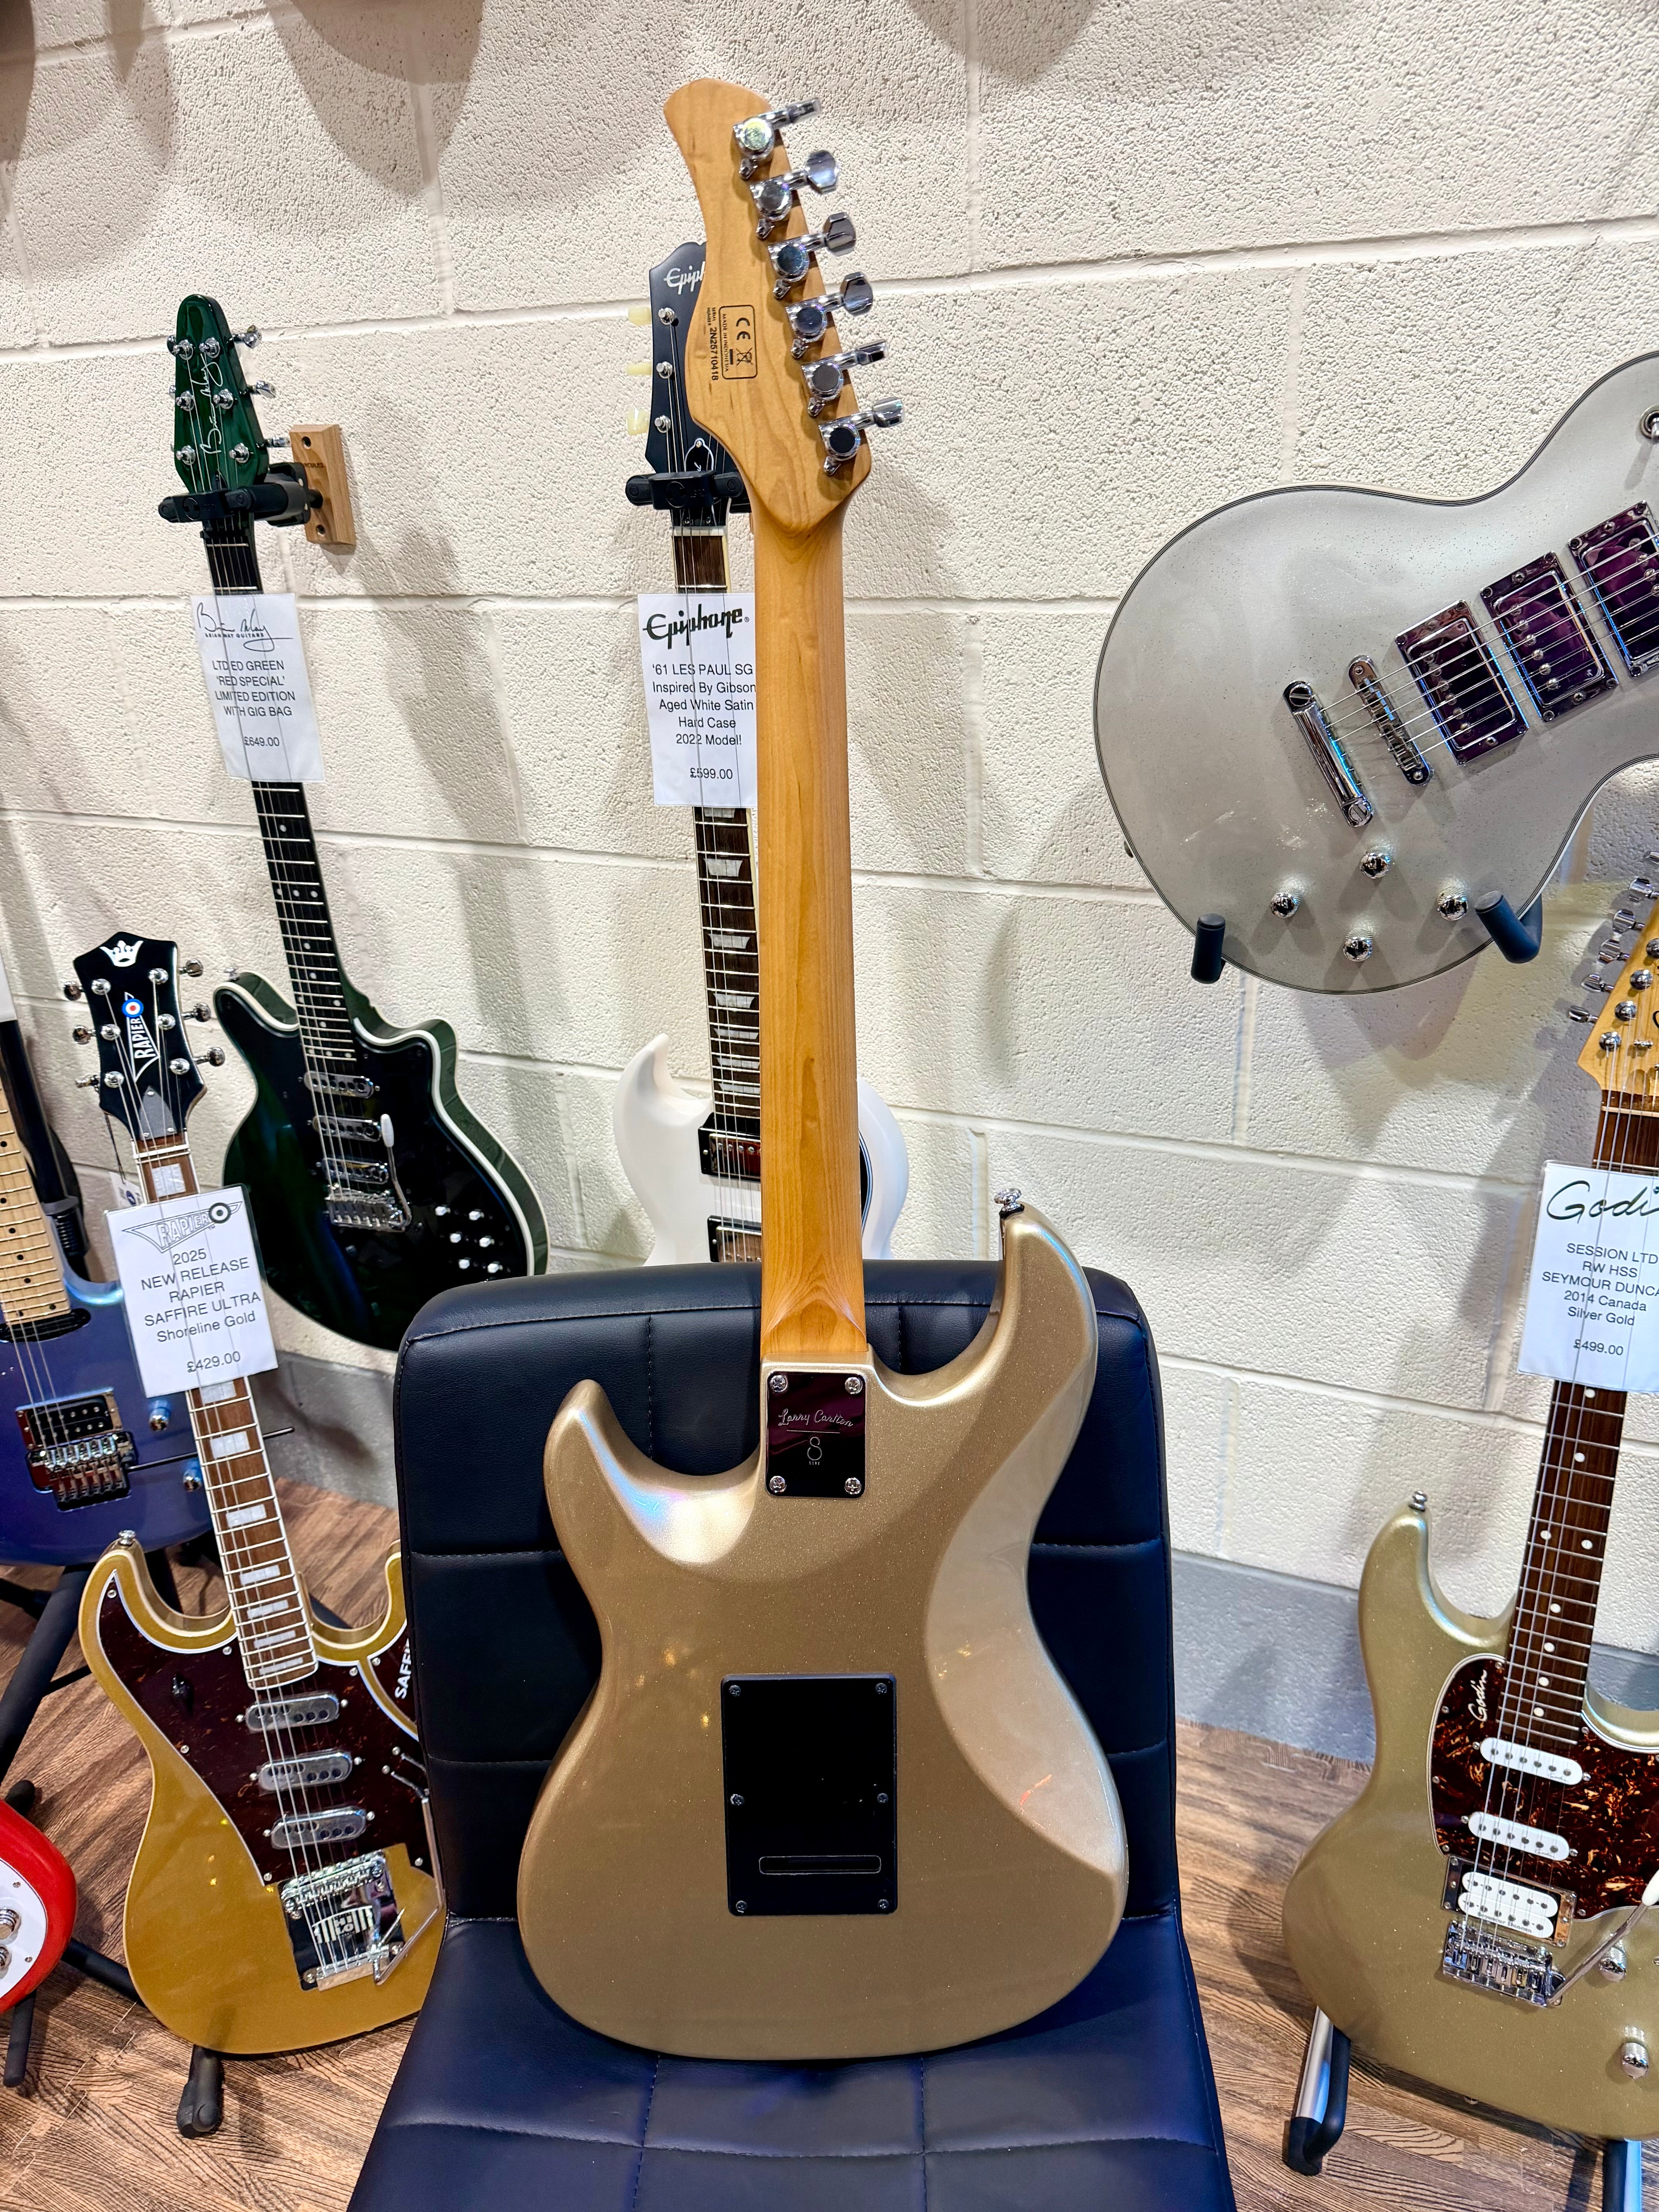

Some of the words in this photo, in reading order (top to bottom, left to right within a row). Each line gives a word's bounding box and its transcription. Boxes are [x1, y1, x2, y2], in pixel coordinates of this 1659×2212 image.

[663, 261, 706, 295] Epip
[643, 603, 743, 650] Epiphone
[212, 660, 228, 670] LTD
[231, 661, 244, 670] ED
[247, 660, 285, 670] GREEN
[672, 664, 695, 675] LES
[699, 664, 731, 675] PAUL
[735, 663, 754, 675] SG
[215, 691, 249, 701] LIMITED
[252, 691, 295, 701] EDITION
[653, 681, 695, 696] Inspired
[699, 682, 713, 696] By
[716, 682, 756, 693] Gibson
[223, 706, 246, 716] WITH
[247, 706, 266, 716] GIG
[269, 706, 292, 716] BAG
[659, 699, 687, 713] Aged
[692, 699, 721, 711] White
[724, 699, 754, 711] Satin
[678, 716, 704, 728] Hard
[707, 716, 736, 728] Case
[244, 737, 280, 747] £649.00
[675, 733, 702, 745] 2022
[705, 734, 742, 745] Model!
[690, 768, 733, 780] £599.00
[130, 1018, 156, 1059] RAPIER
[1546, 1180, 1659, 1224] Godi
[156, 1212, 210, 1249] RAPIER
[173, 1248, 207, 1265] 2025
[1566, 1243, 1628, 1261] SESSION
[1632, 1251, 1659, 1264] LTD
[141, 1272, 176, 1290] NEW
[180, 1257, 250, 1282] RELEASE
[1582, 1261, 1606, 1273] RW
[1609, 1264, 1638, 1278] HSS
[169, 1281, 225, 1303] RAPIER
[1541, 1271, 1611, 1291] SEYMOUR
[1615, 1281, 1659, 1297] DUNCA
[144, 1302, 208, 1326] SAFFIRE
[211, 1291, 261, 1312] ULTRA
[1563, 1290, 1594, 1303] 2014
[1598, 1295, 1647, 1312] Canada
[1568, 1307, 1602, 1321] Silver
[1606, 1312, 1635, 1326] Gold
[156, 1320, 220, 1343] Shoreline
[224, 1310, 256, 1327] Gold
[1573, 1338, 1624, 1356] £499.00
[187, 1351, 241, 1373] £429.00
[778, 1408, 810, 1426] Larry
[814, 1409, 854, 1427] Carlton
